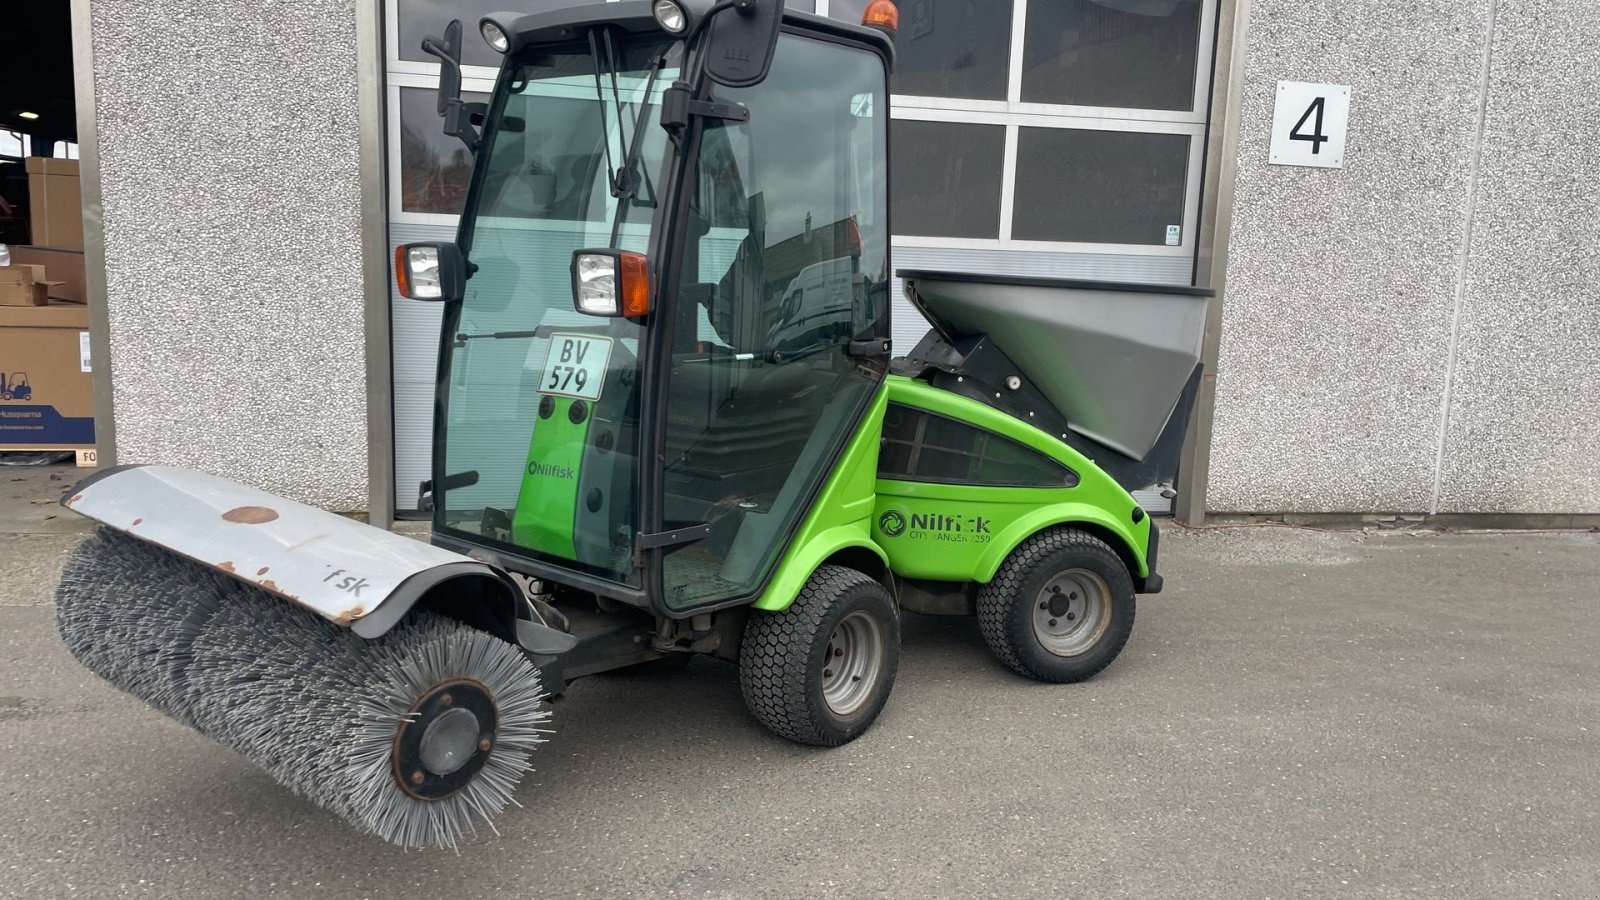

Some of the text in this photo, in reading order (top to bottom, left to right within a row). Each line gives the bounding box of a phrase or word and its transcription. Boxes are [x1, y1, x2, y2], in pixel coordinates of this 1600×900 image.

[1289, 97, 1328, 154] 4
[560, 339, 590, 364] BV
[549, 366, 588, 392] 579
[537, 463, 574, 480] Nilfisk
